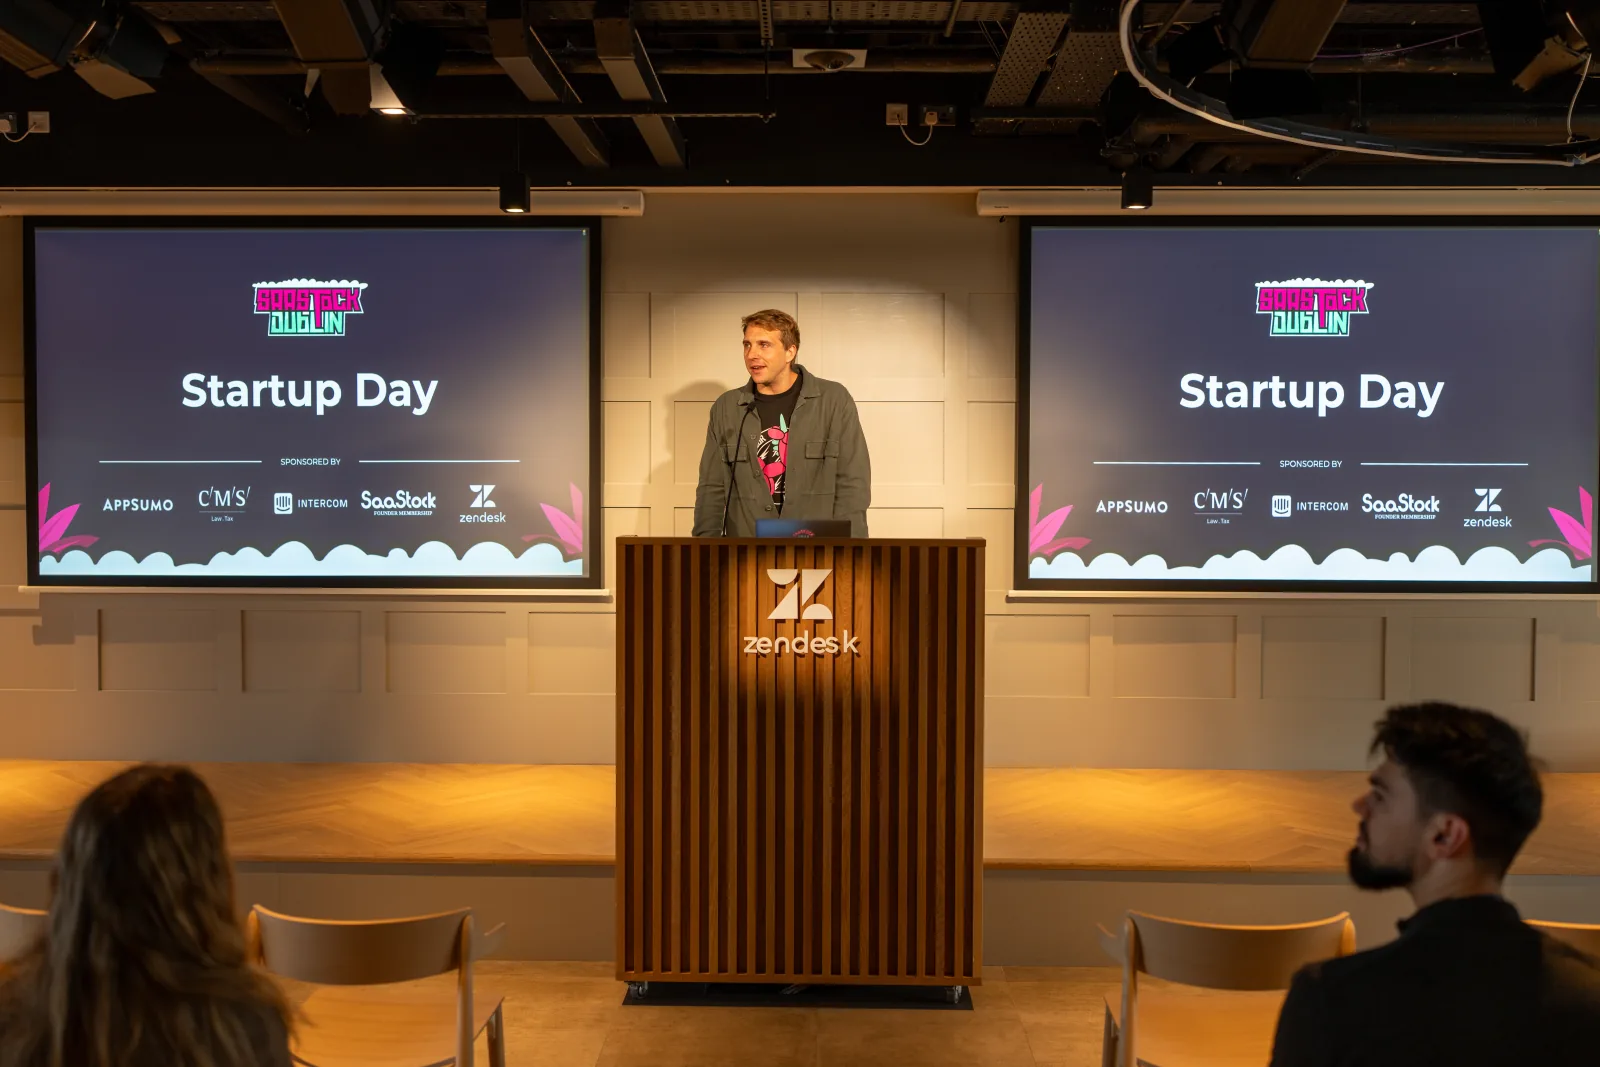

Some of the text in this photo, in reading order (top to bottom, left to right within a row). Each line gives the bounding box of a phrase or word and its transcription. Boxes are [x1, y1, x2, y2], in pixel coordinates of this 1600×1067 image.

[181, 372, 439, 416] Startup Day
[1179, 372, 1445, 418] Startup Day
[280, 457, 341, 466] SPONSORED BY
[1279, 459, 1343, 468] SPONSORED BY
[102, 497, 174, 512] APPSUMO
[297, 498, 348, 508] INTERCOM
[360, 490, 437, 510] SaaStock
[1095, 499, 1169, 514] APPSUMO
[1296, 501, 1349, 511] INTERCOM
[1361, 493, 1440, 513] SaaStock
[459, 511, 507, 523] zendesk
[1463, 515, 1513, 528] zendesk
[743, 629, 859, 655] zendesk
